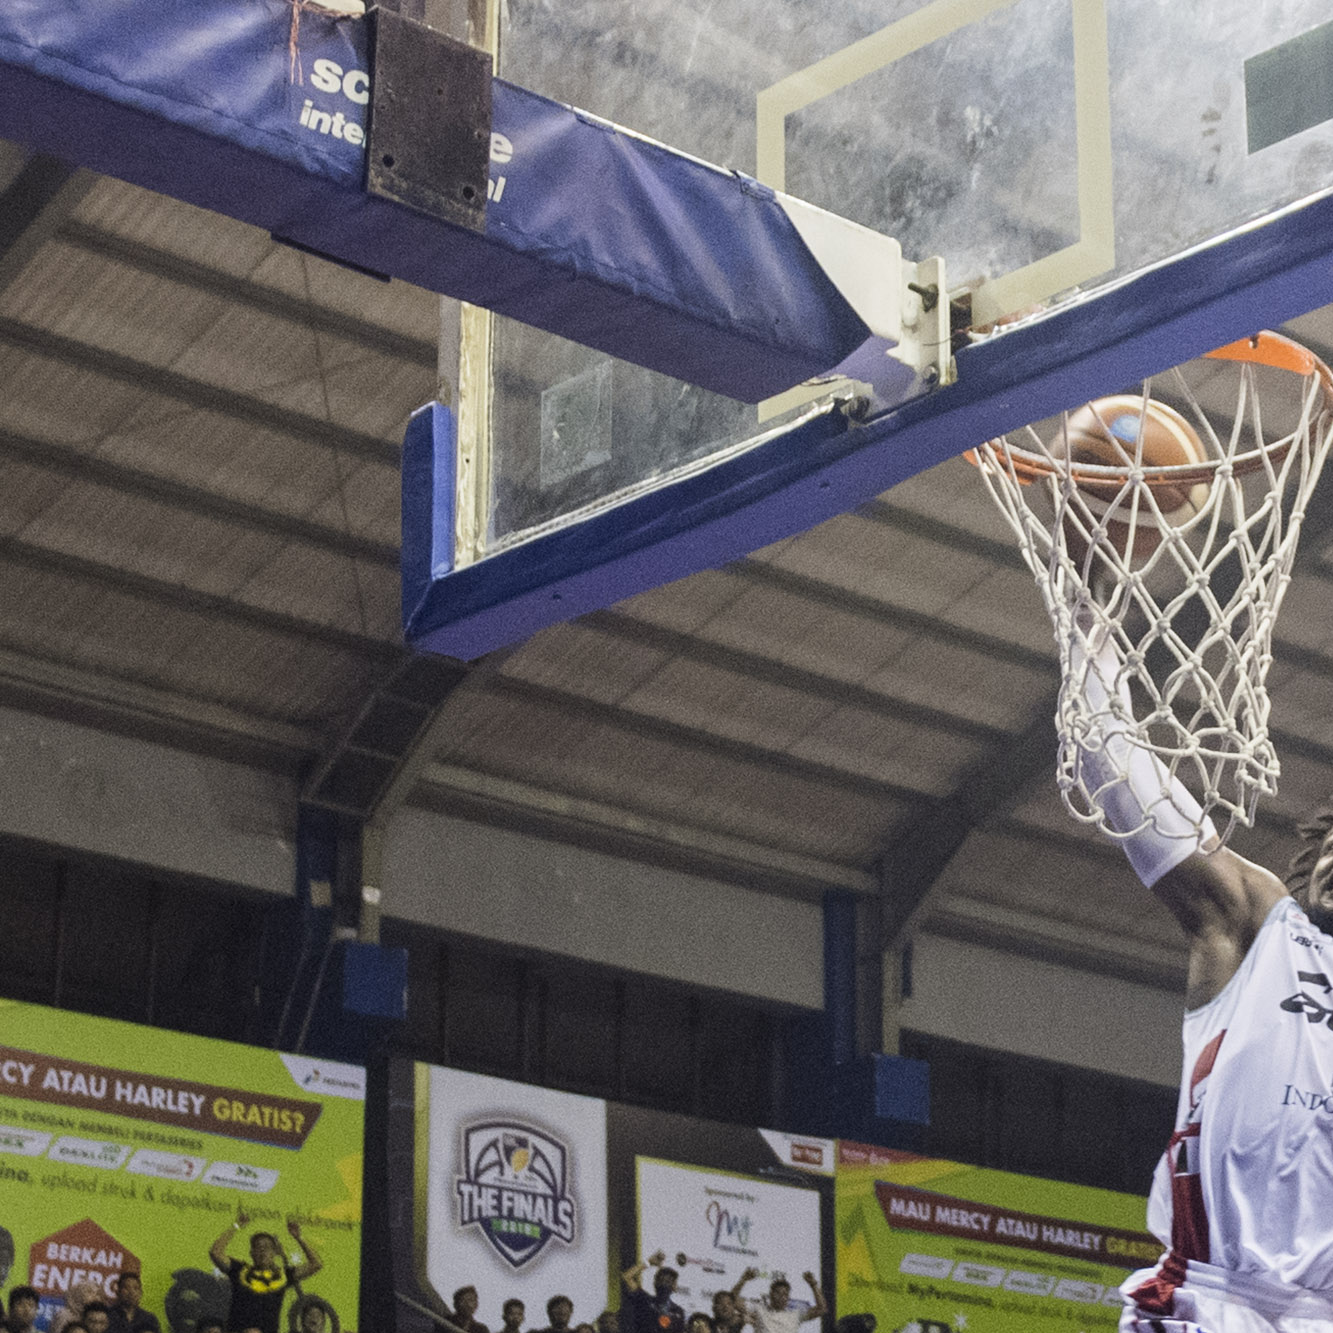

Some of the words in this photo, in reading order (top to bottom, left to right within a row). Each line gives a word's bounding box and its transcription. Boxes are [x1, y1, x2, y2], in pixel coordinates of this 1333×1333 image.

[42, 1067, 108, 1100] ATAU
[115, 1080, 206, 1116] HARLEY
[212, 1097, 306, 1135] GRATIS?
[459, 1182, 500, 1222] THE
[501, 1190, 573, 1242] FINALS
[889, 1198, 931, 1222] MAU
[935, 1206, 992, 1232] MERCY
[995, 1215, 1040, 1241] ATAU
[1042, 1225, 1102, 1251] HARLEY
[46, 1242, 124, 1268] BERKAH
